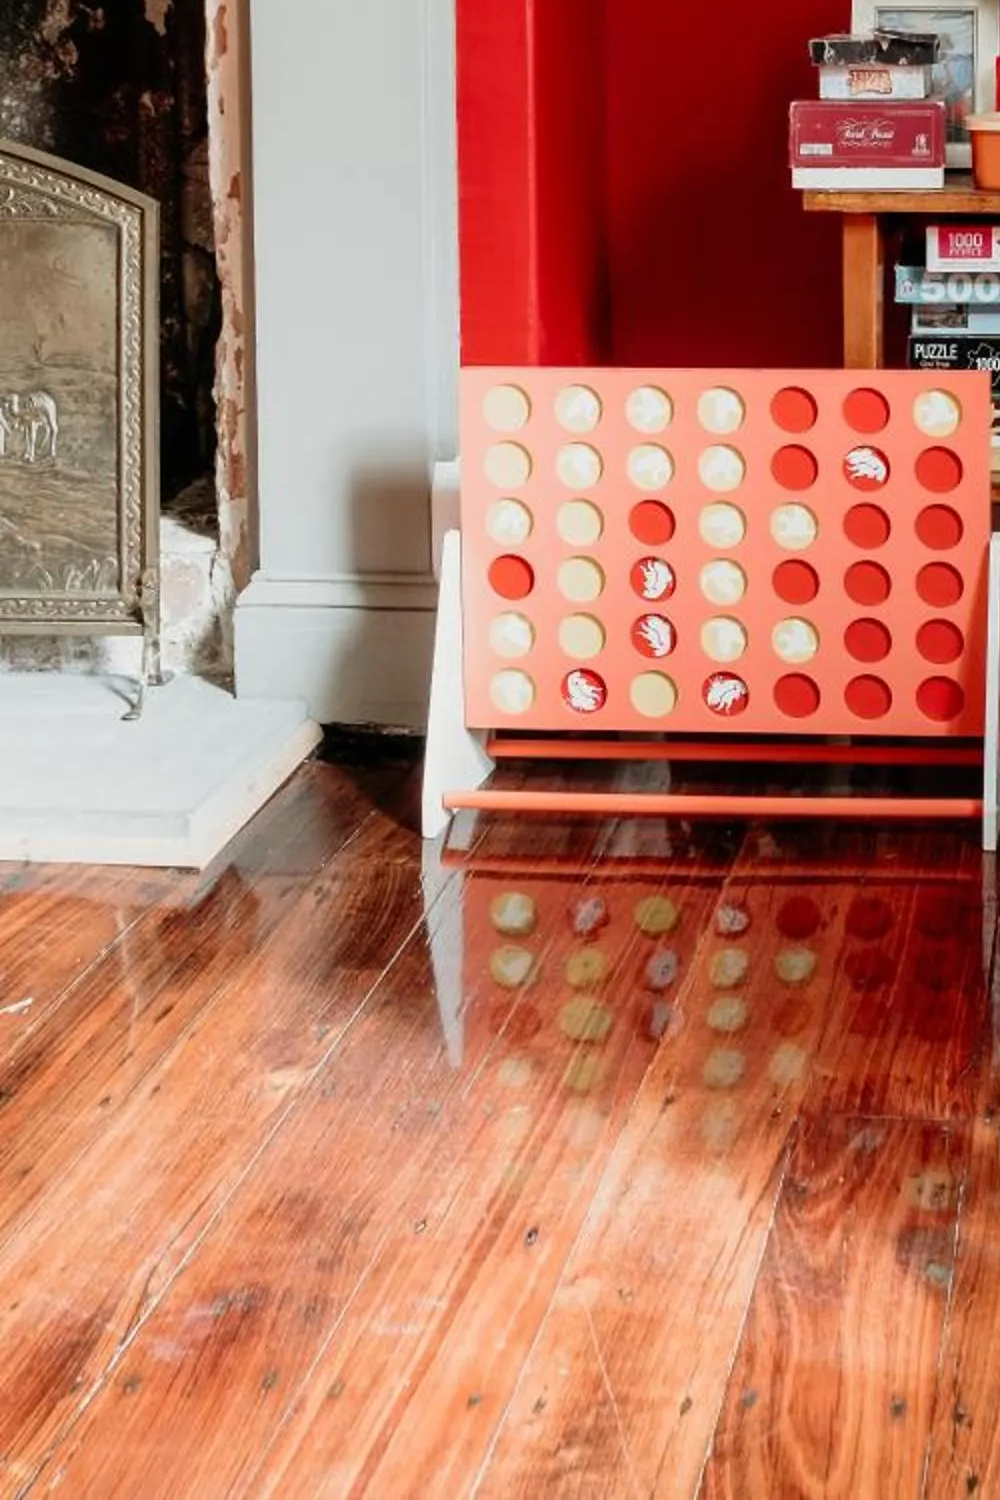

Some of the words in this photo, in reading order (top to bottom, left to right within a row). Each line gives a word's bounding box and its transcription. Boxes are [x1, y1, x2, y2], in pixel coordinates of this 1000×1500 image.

[948, 233, 983, 247] 1000
[920, 272, 1000, 301] 500
[915, 343, 959, 360] PUZZLE
[976, 357, 1000, 371] 1000
